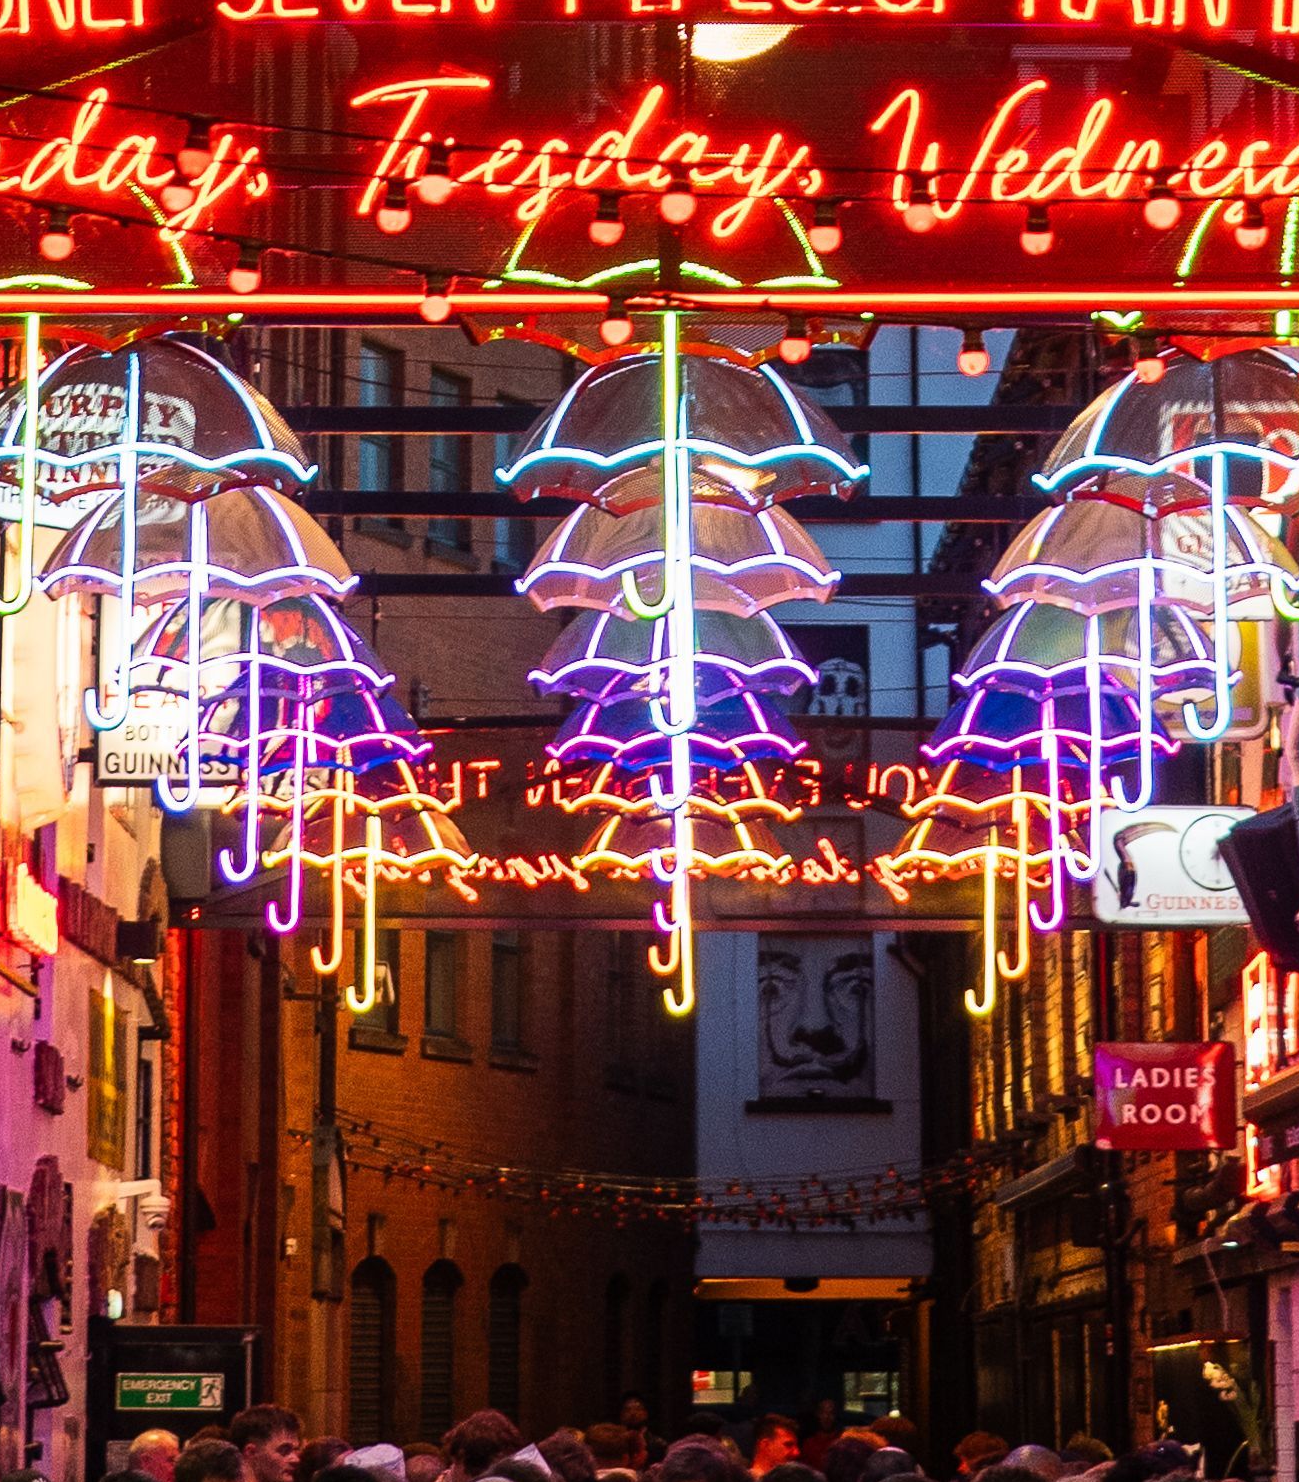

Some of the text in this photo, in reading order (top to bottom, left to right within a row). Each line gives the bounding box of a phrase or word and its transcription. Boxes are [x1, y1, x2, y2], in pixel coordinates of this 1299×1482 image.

[1147, 894, 1244, 911] GUINNES
[1115, 1067, 1216, 1089] LADIES
[1122, 1103, 1207, 1125] ROOM
[122, 1379, 197, 1391] EMERGENCY
[146, 1392, 173, 1403] EXIT
